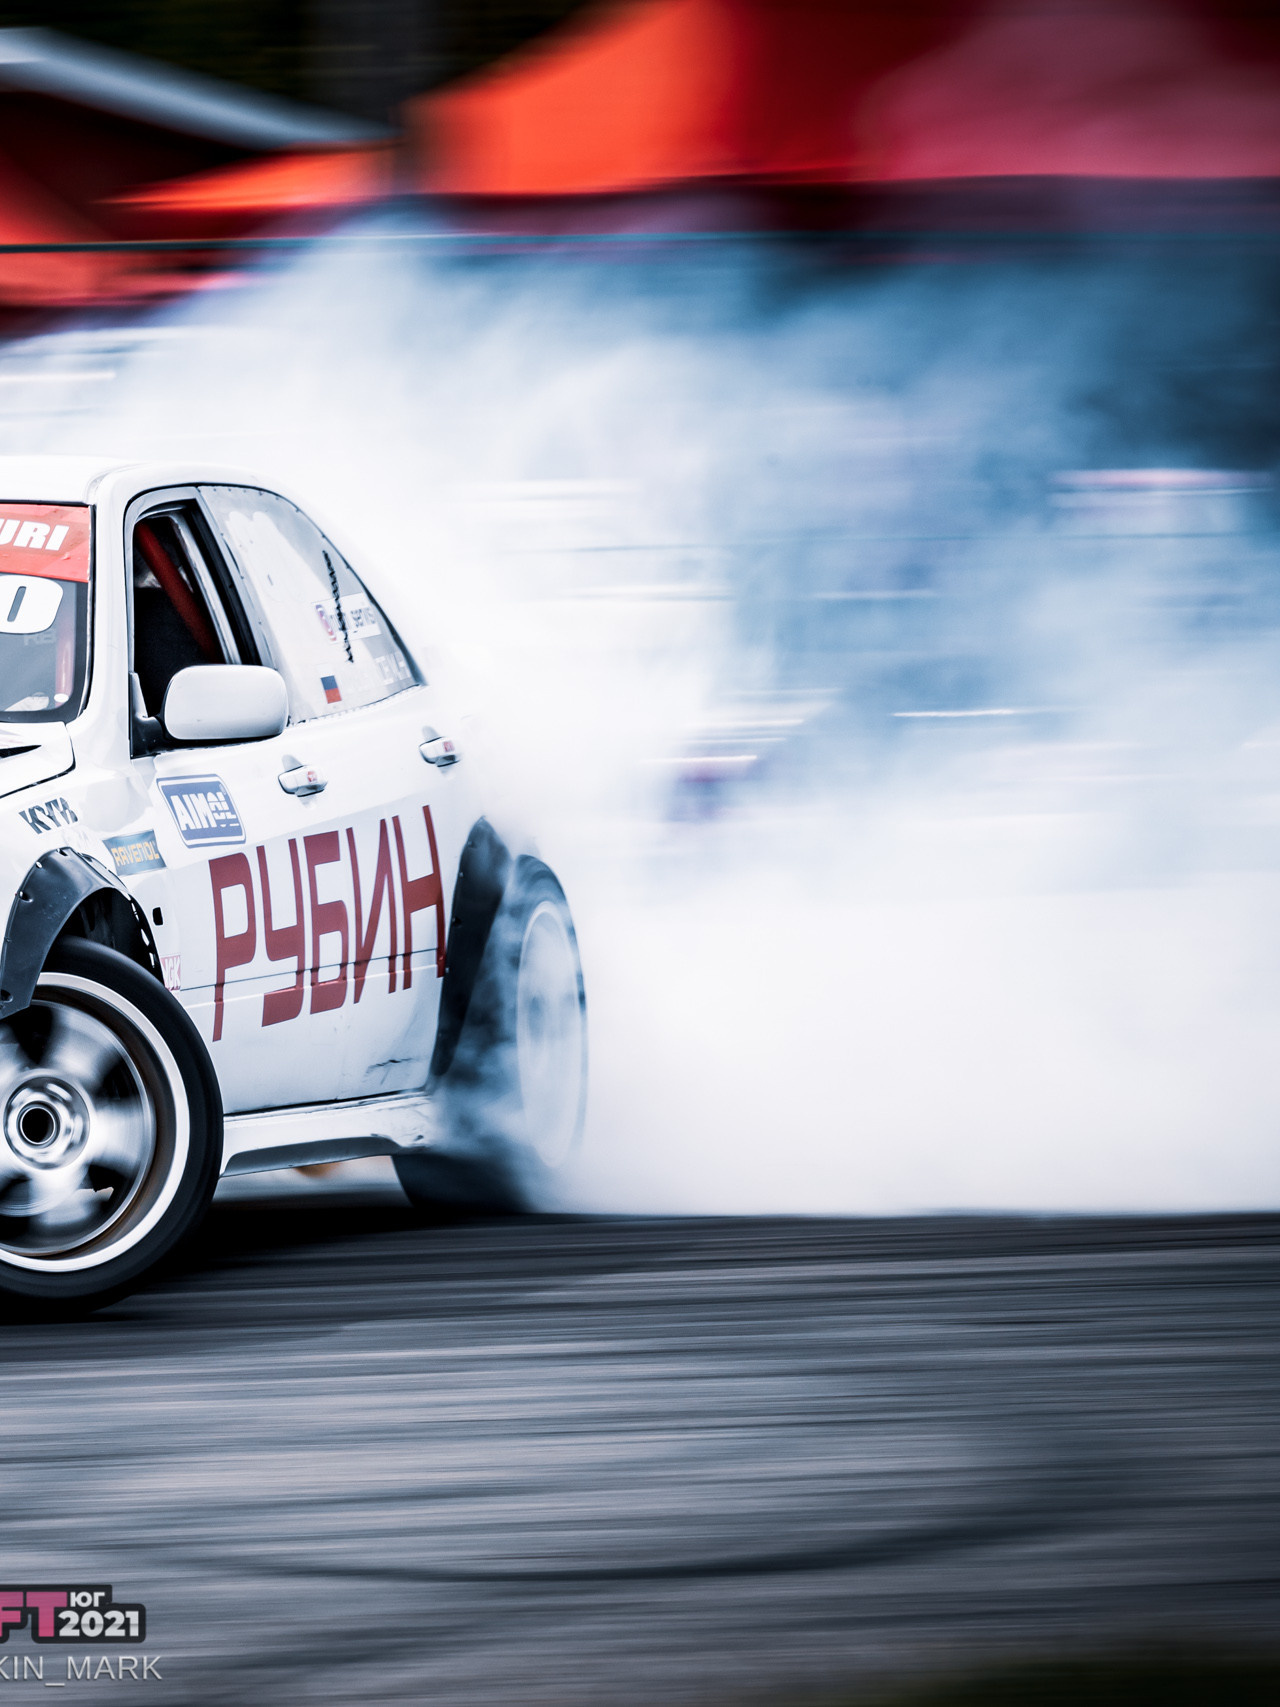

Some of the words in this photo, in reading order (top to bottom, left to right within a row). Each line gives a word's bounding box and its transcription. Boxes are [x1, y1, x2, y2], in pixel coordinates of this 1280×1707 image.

[18, 797, 78, 834] KYB
[111, 840, 160, 867] RAVENOL
[208, 805, 446, 1042] РУБИН
